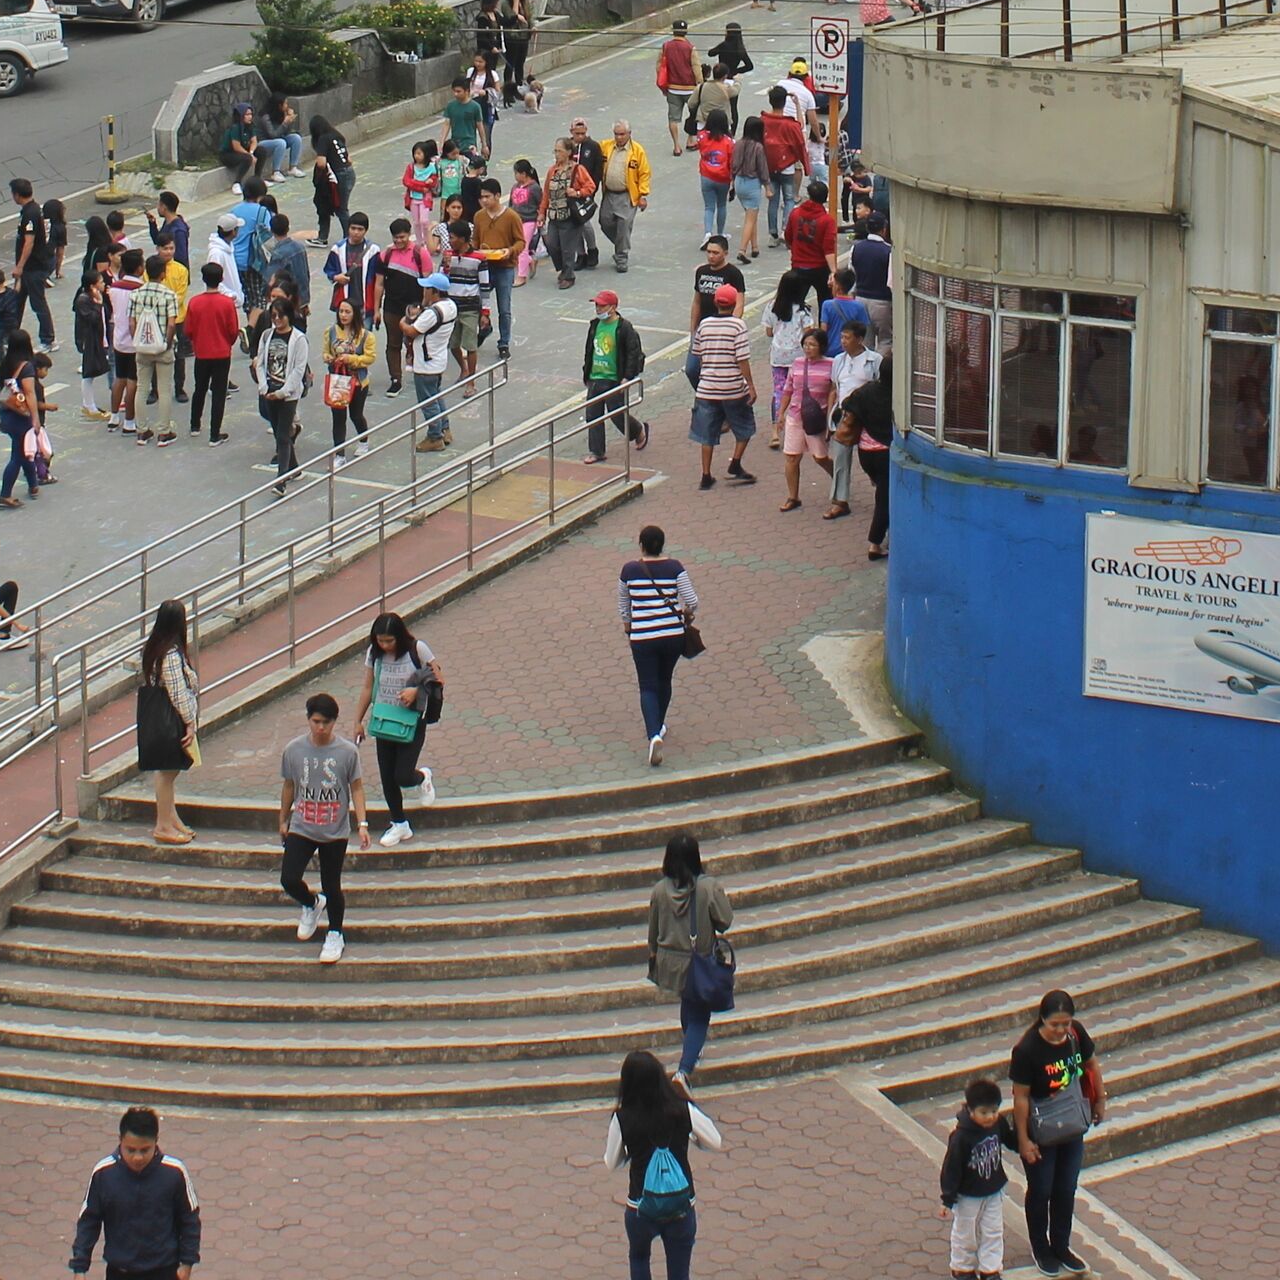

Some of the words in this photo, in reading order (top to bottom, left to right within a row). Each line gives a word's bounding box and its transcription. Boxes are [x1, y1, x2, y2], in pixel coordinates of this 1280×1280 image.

[1091, 557, 1196, 586] GRACIOUS
[1136, 585, 1180, 601] TRAVEL
[1183, 592, 1192, 602] &
[1196, 593, 1237, 609] TOURS
[1134, 604, 1155, 615] your
[1156, 606, 1190, 618] passion
[1190, 609, 1205, 620] for
[1207, 612, 1234, 624] travel
[319, 787, 341, 801] MY
